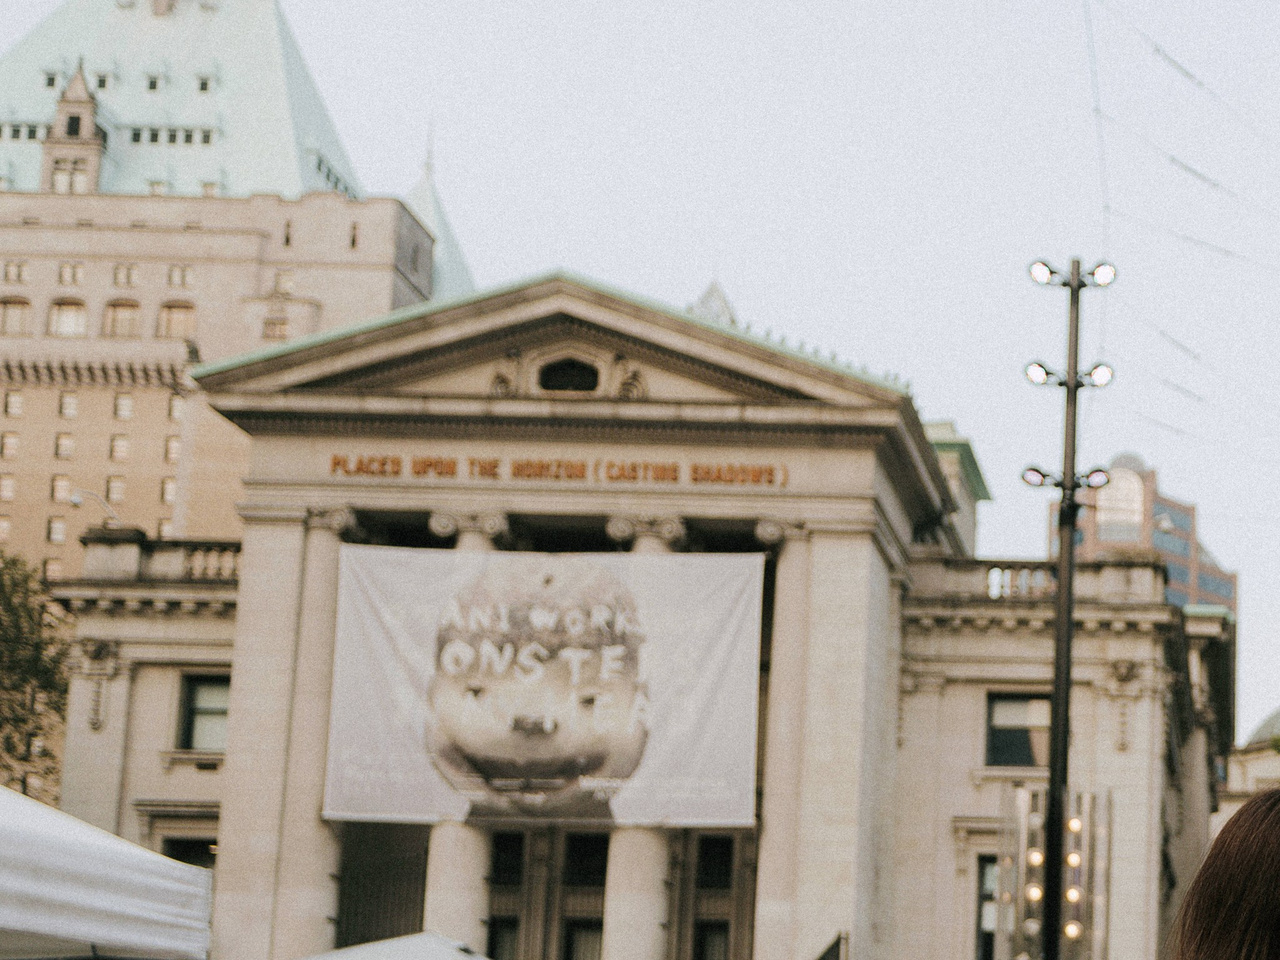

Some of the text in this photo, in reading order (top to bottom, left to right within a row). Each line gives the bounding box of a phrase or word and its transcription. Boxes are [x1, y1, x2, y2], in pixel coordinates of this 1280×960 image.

[412, 456, 457, 477] UPON
[468, 458, 499, 479] THE
[511, 460, 587, 479] HORIZON
